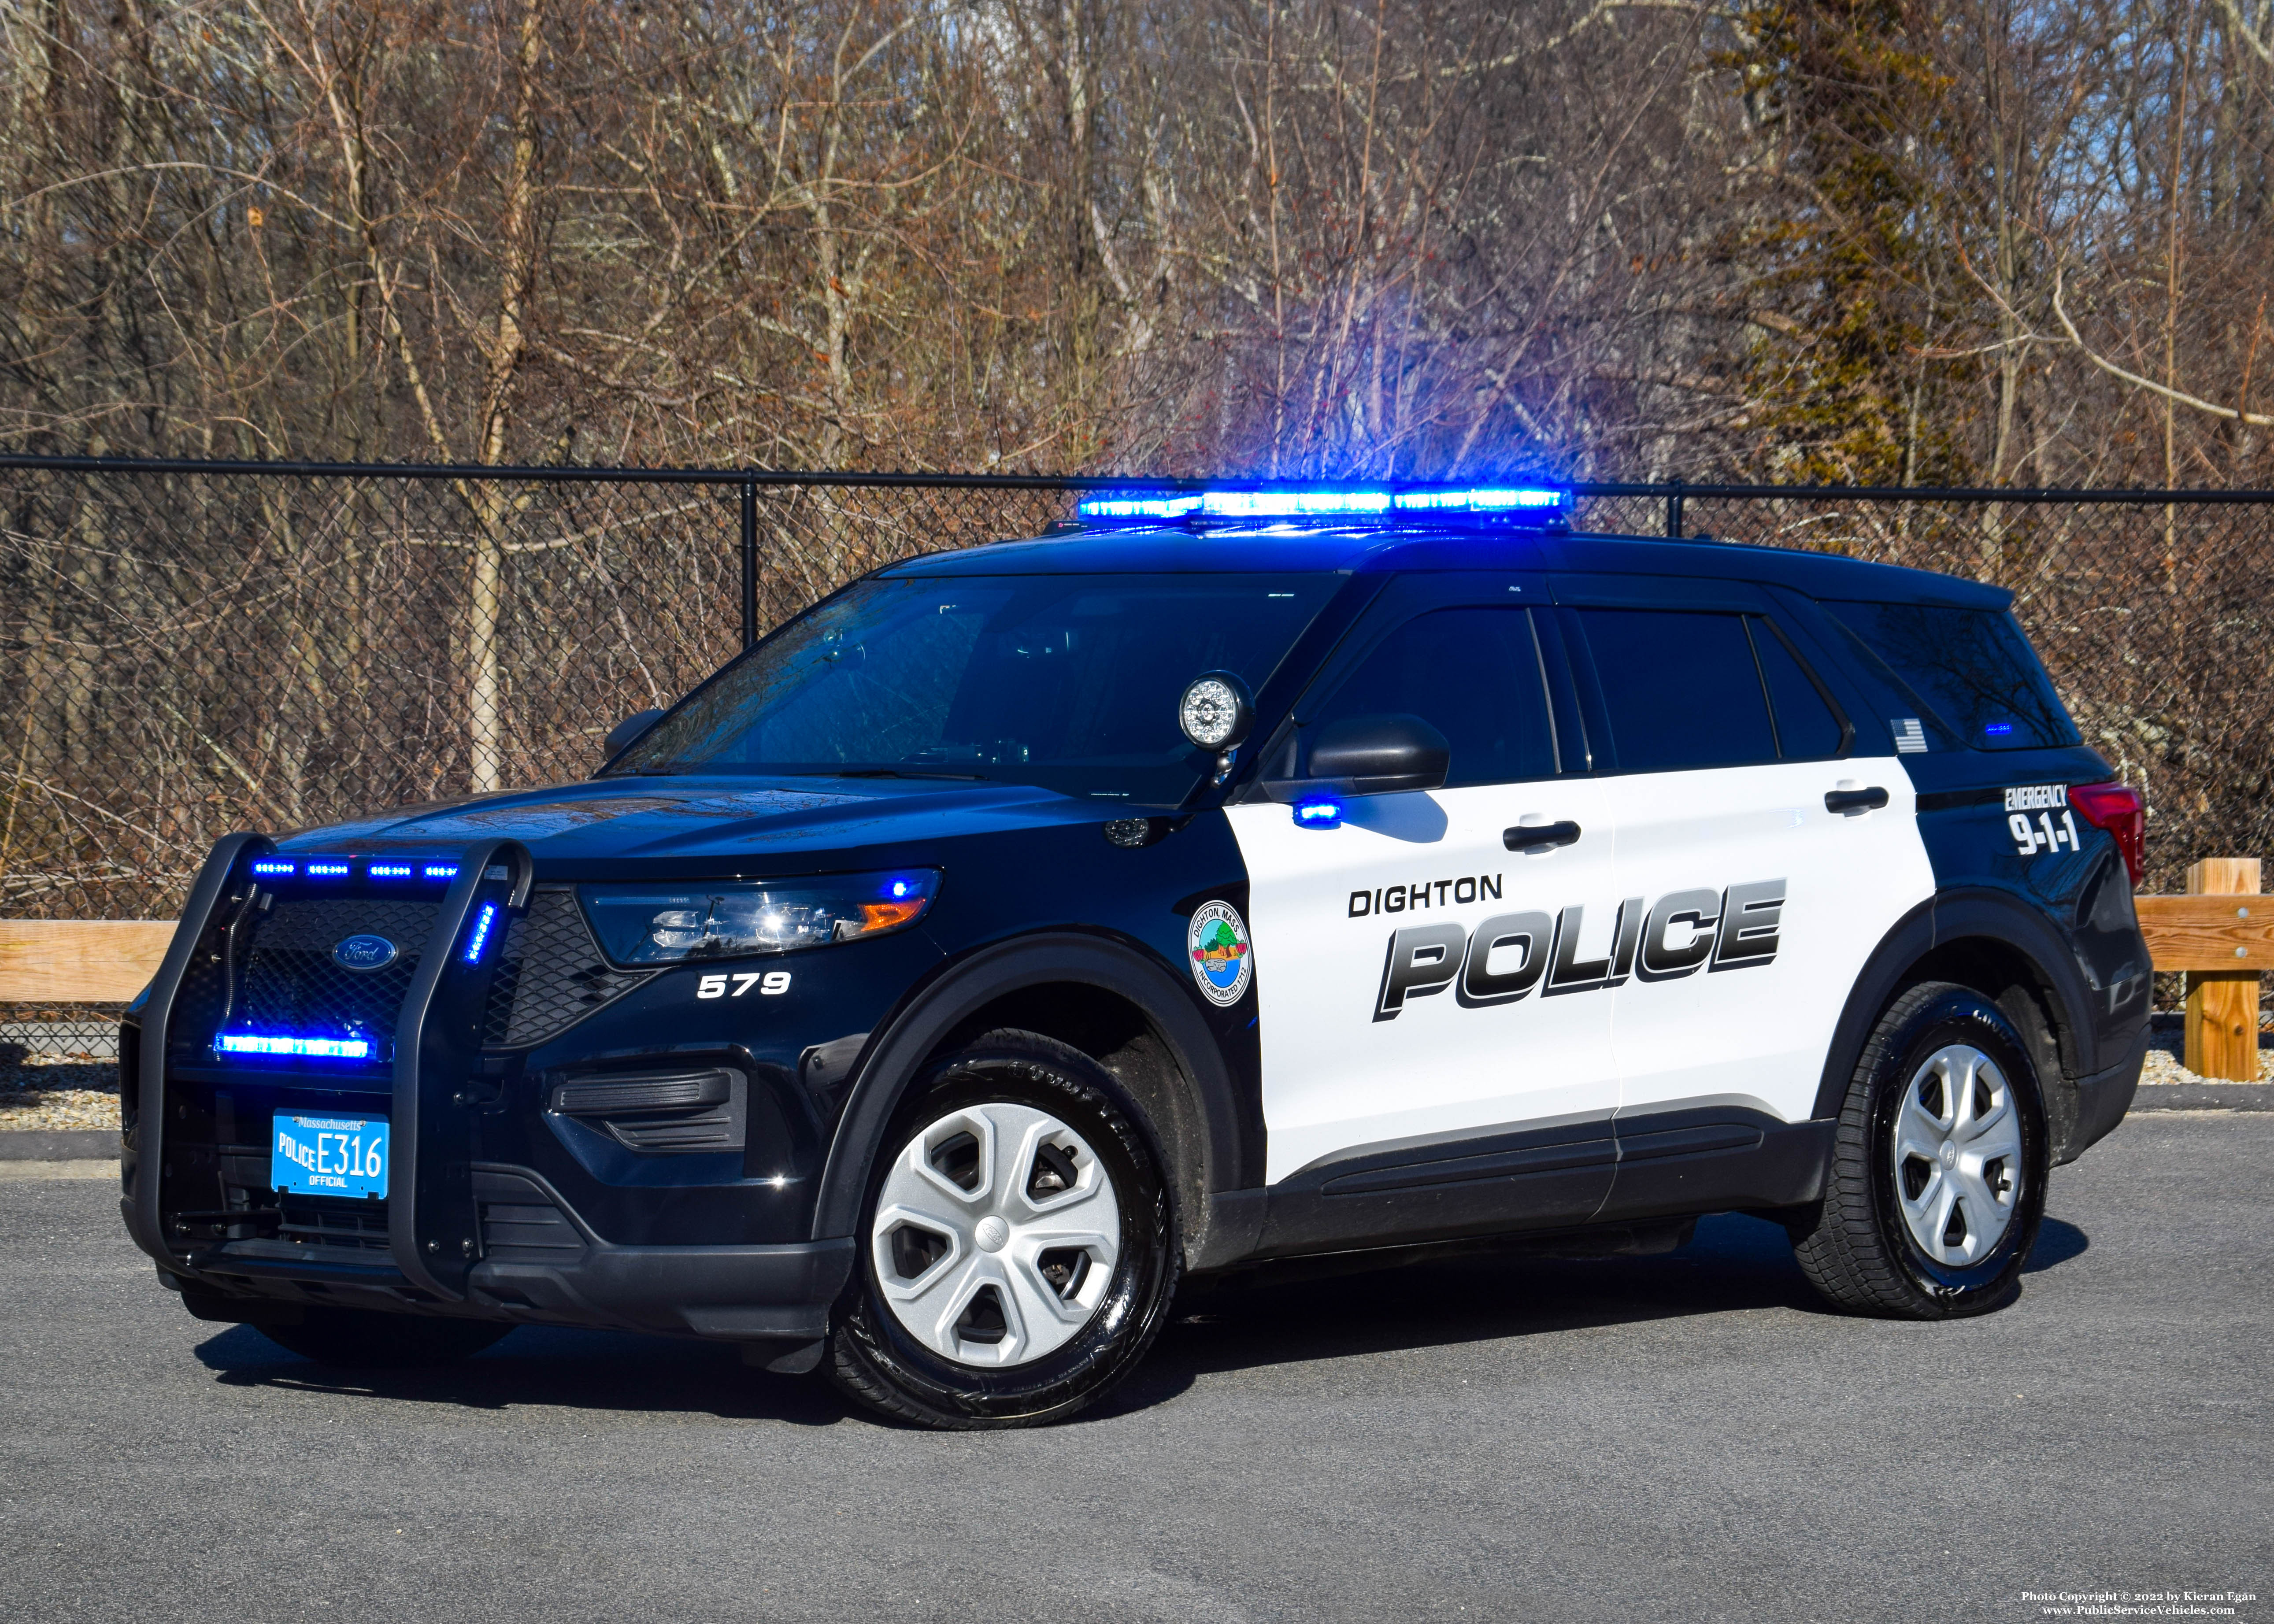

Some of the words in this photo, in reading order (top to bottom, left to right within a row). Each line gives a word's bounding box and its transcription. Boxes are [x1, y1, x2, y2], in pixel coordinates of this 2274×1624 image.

[2005, 784, 2067, 811] EMERGENCY
[2008, 810, 2080, 855] 9-1-1
[1348, 873, 1502, 918] DIGHTON
[1193, 907, 1220, 938] DIGHTON,
[1222, 910, 1239, 935] MASS.
[344, 941, 379, 961] Ford
[1372, 877, 1788, 1023] POLICE
[697, 972, 791, 999] 579
[1199, 969, 1238, 998] INCORPORATED
[1237, 967, 1247, 986] 1712
[298, 1117, 361, 1131] Massachusetts
[1007, 1060, 1149, 1169] GOODYEAR
[278, 1132, 316, 1172] POLICE
[318, 1133, 382, 1177] E316
[309, 1176, 348, 1187] OFFICIAL
